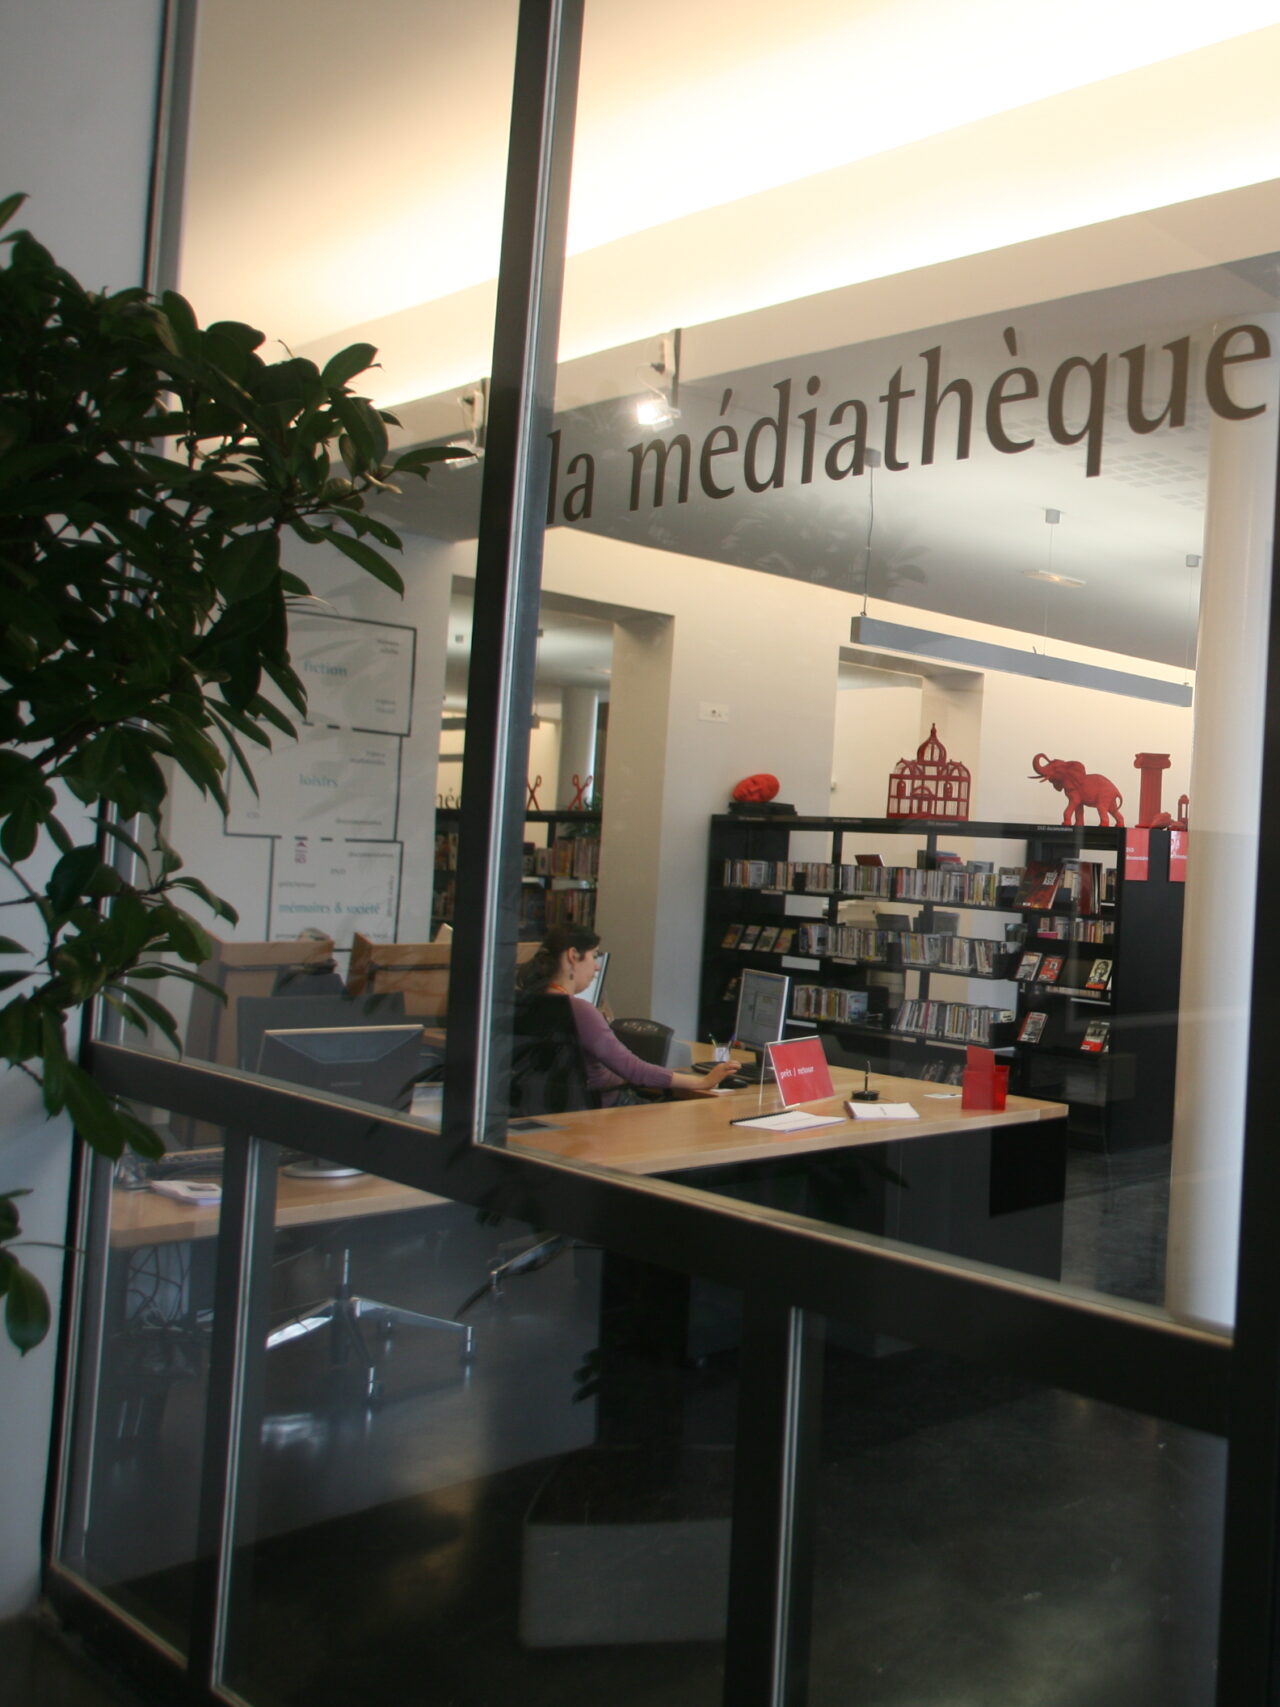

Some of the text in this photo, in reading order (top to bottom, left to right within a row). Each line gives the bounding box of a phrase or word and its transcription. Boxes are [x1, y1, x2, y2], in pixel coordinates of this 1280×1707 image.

[546, 322, 1272, 525] la médiathèque
[298, 773, 338, 788] loisirs
